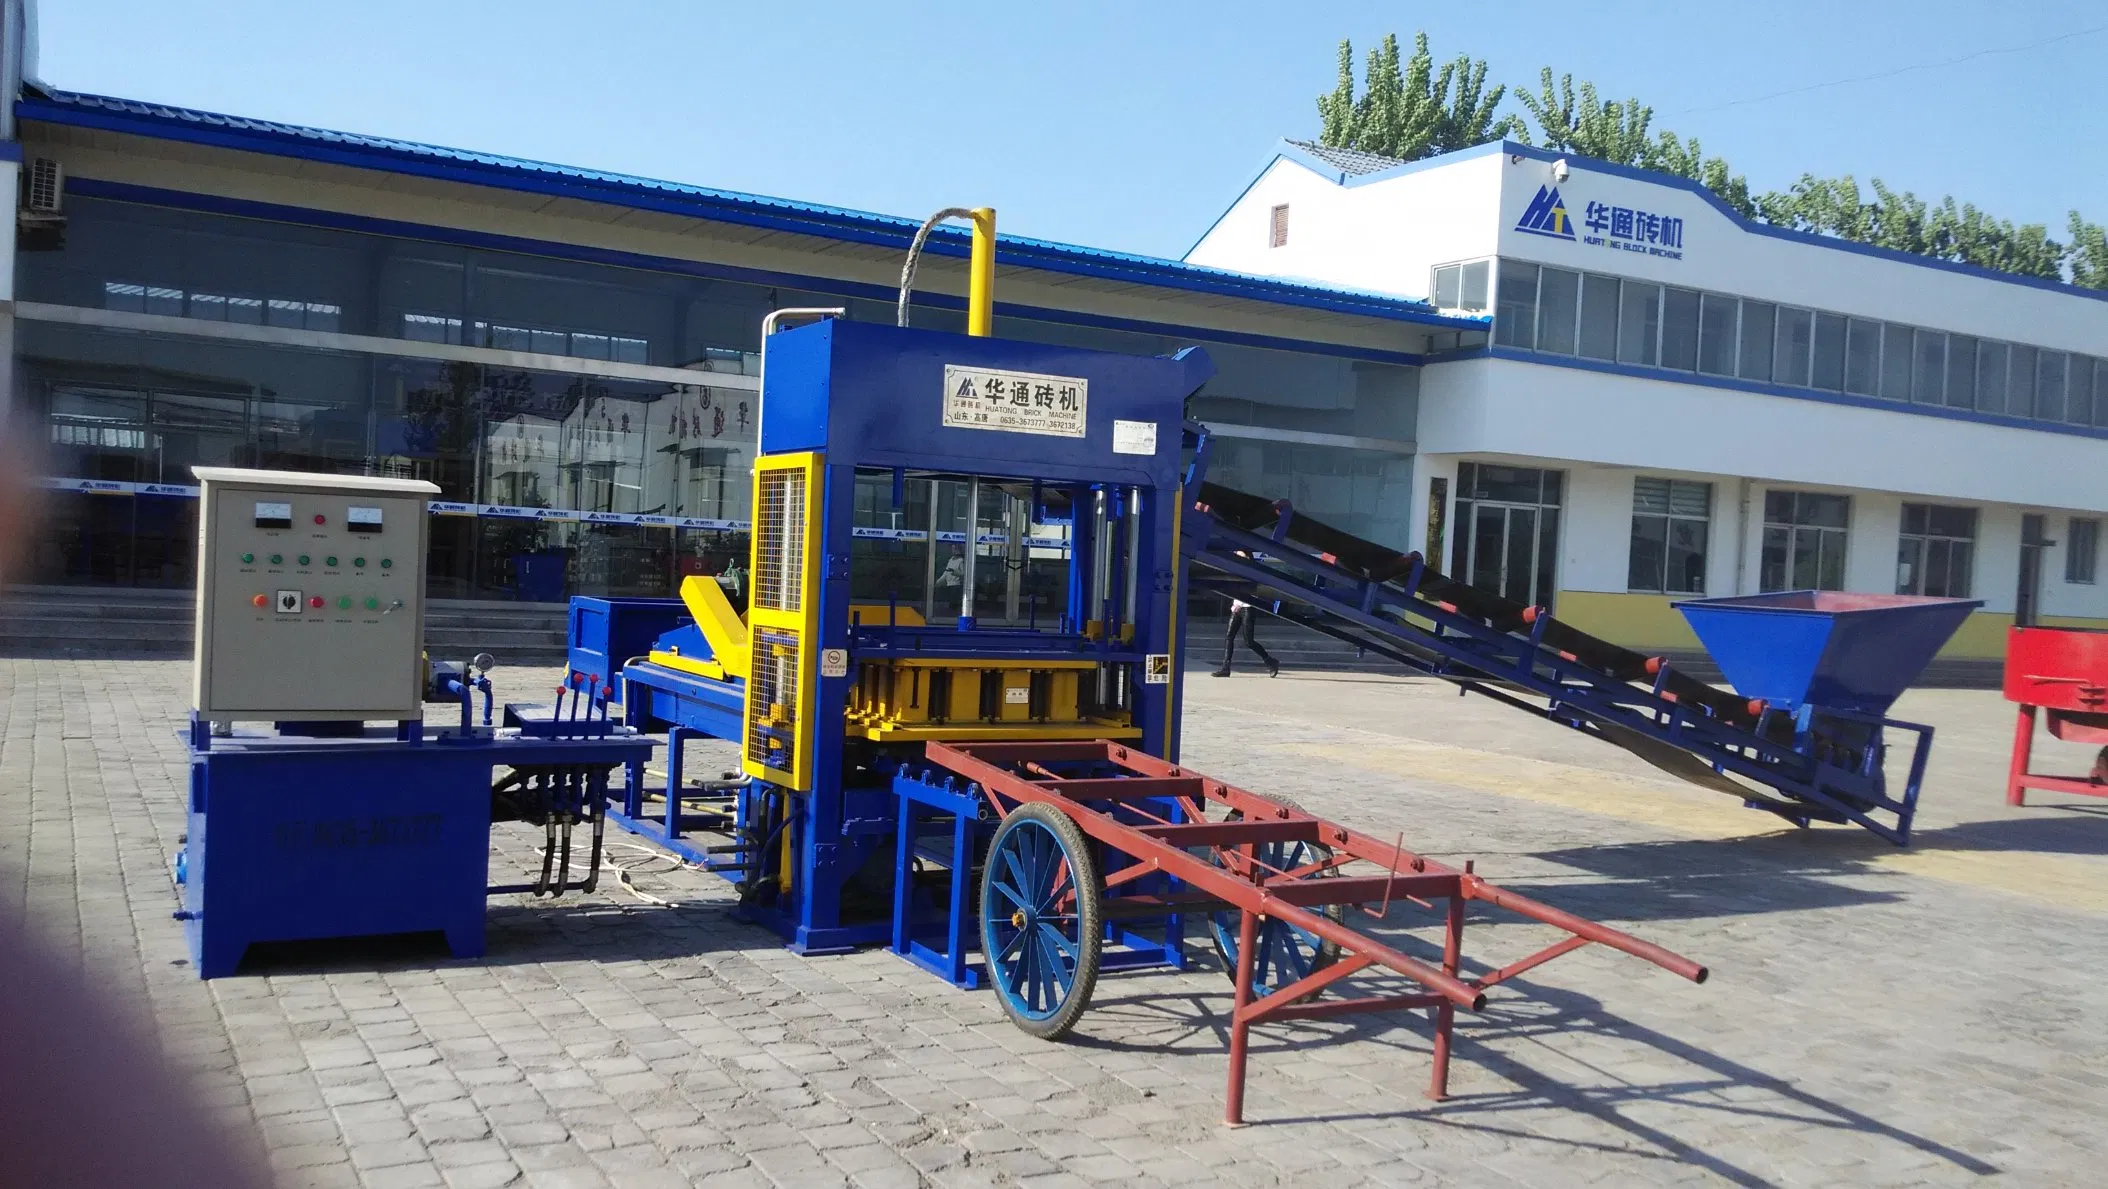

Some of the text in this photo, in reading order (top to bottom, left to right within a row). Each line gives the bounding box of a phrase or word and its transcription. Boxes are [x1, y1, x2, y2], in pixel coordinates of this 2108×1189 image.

[1585, 201, 1683, 249] 华通砖机
[1623, 242, 1648, 255] BLOCK
[1649, 247, 1683, 260] MACHINE
[984, 378, 1079, 411] 华通砖机
[985, 405, 1077, 420] HUATONG BRICK MACHINE
